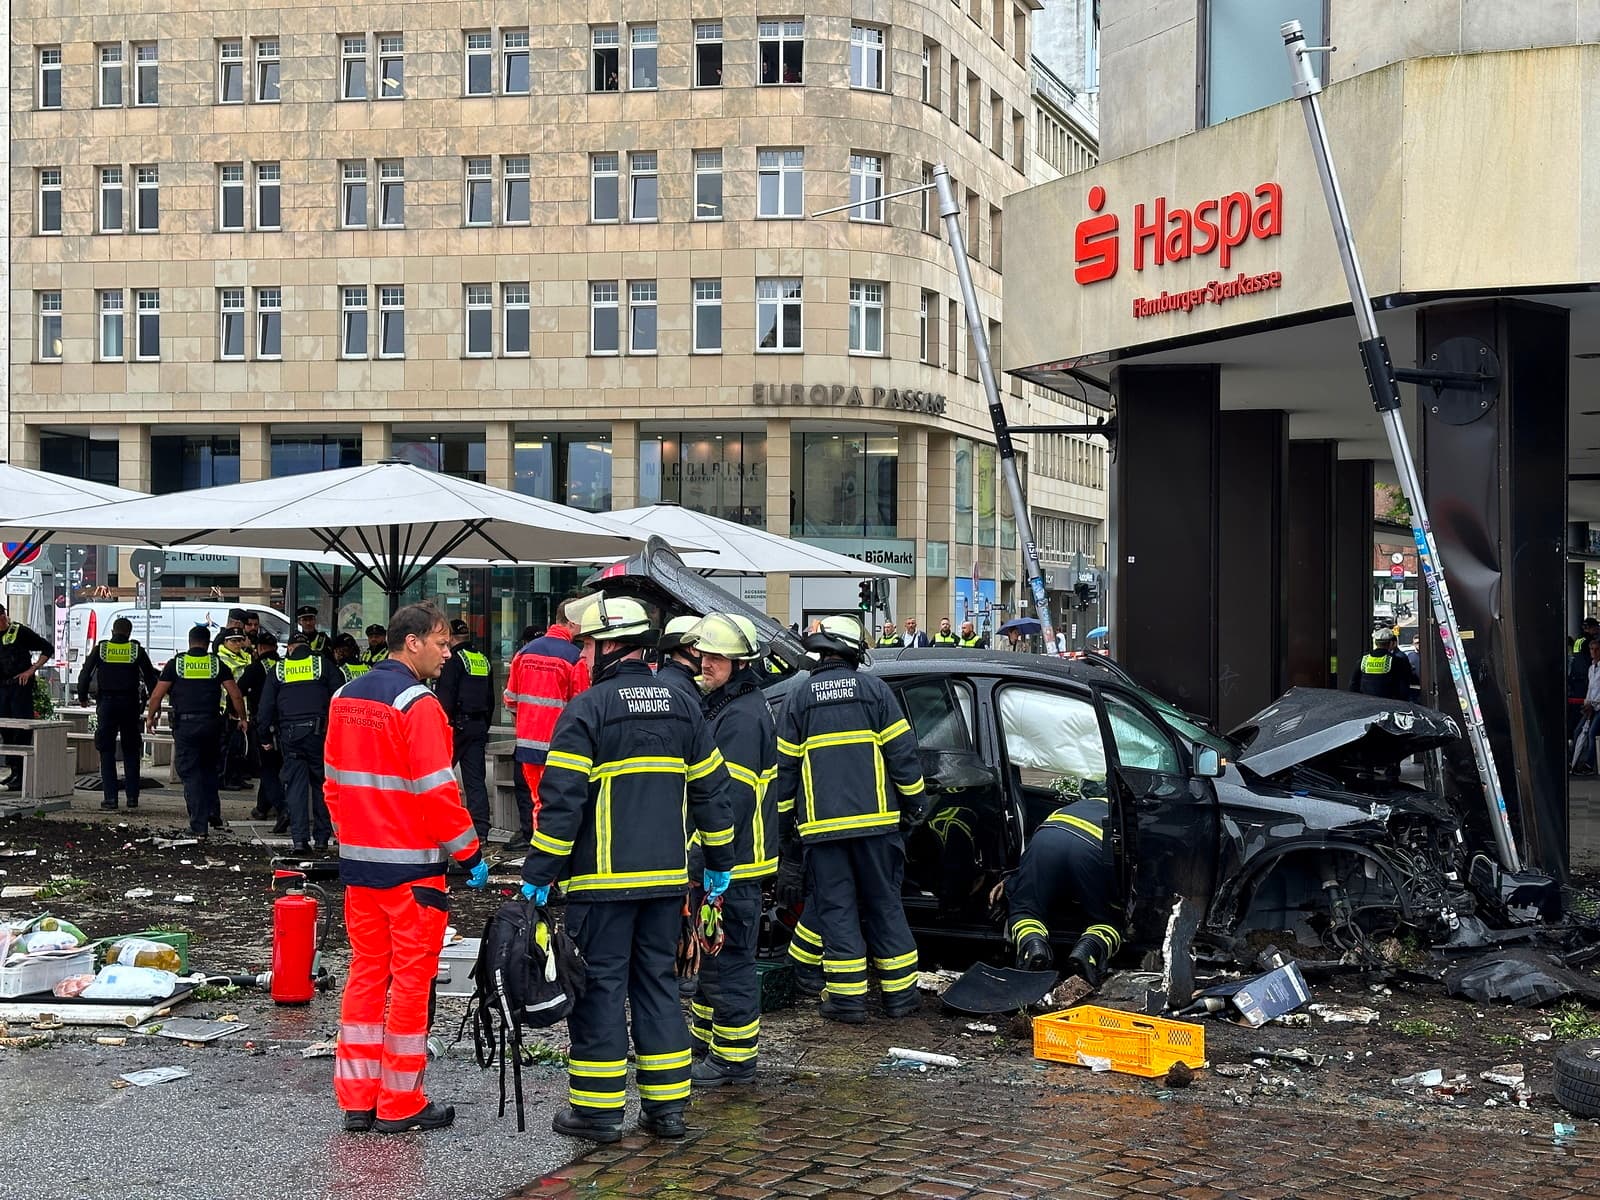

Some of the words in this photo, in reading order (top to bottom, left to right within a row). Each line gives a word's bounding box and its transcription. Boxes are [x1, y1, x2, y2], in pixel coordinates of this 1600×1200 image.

[1133, 181, 1283, 271] Haspa
[1132, 286, 1207, 318] Hamburger
[1204, 270, 1282, 305] Sparkasse
[753, 383, 864, 406] EUROPA
[107, 648, 130, 656] POLIZEI
[186, 662, 210, 671] POLIZEI
[285, 665, 312, 676] POLIZEI
[811, 678, 857, 693] FEUERWEHR
[618, 687, 672, 700] FEUERWEHR
[816, 688, 854, 702] HAMBURG
[627, 699, 670, 712] HAMBURG
